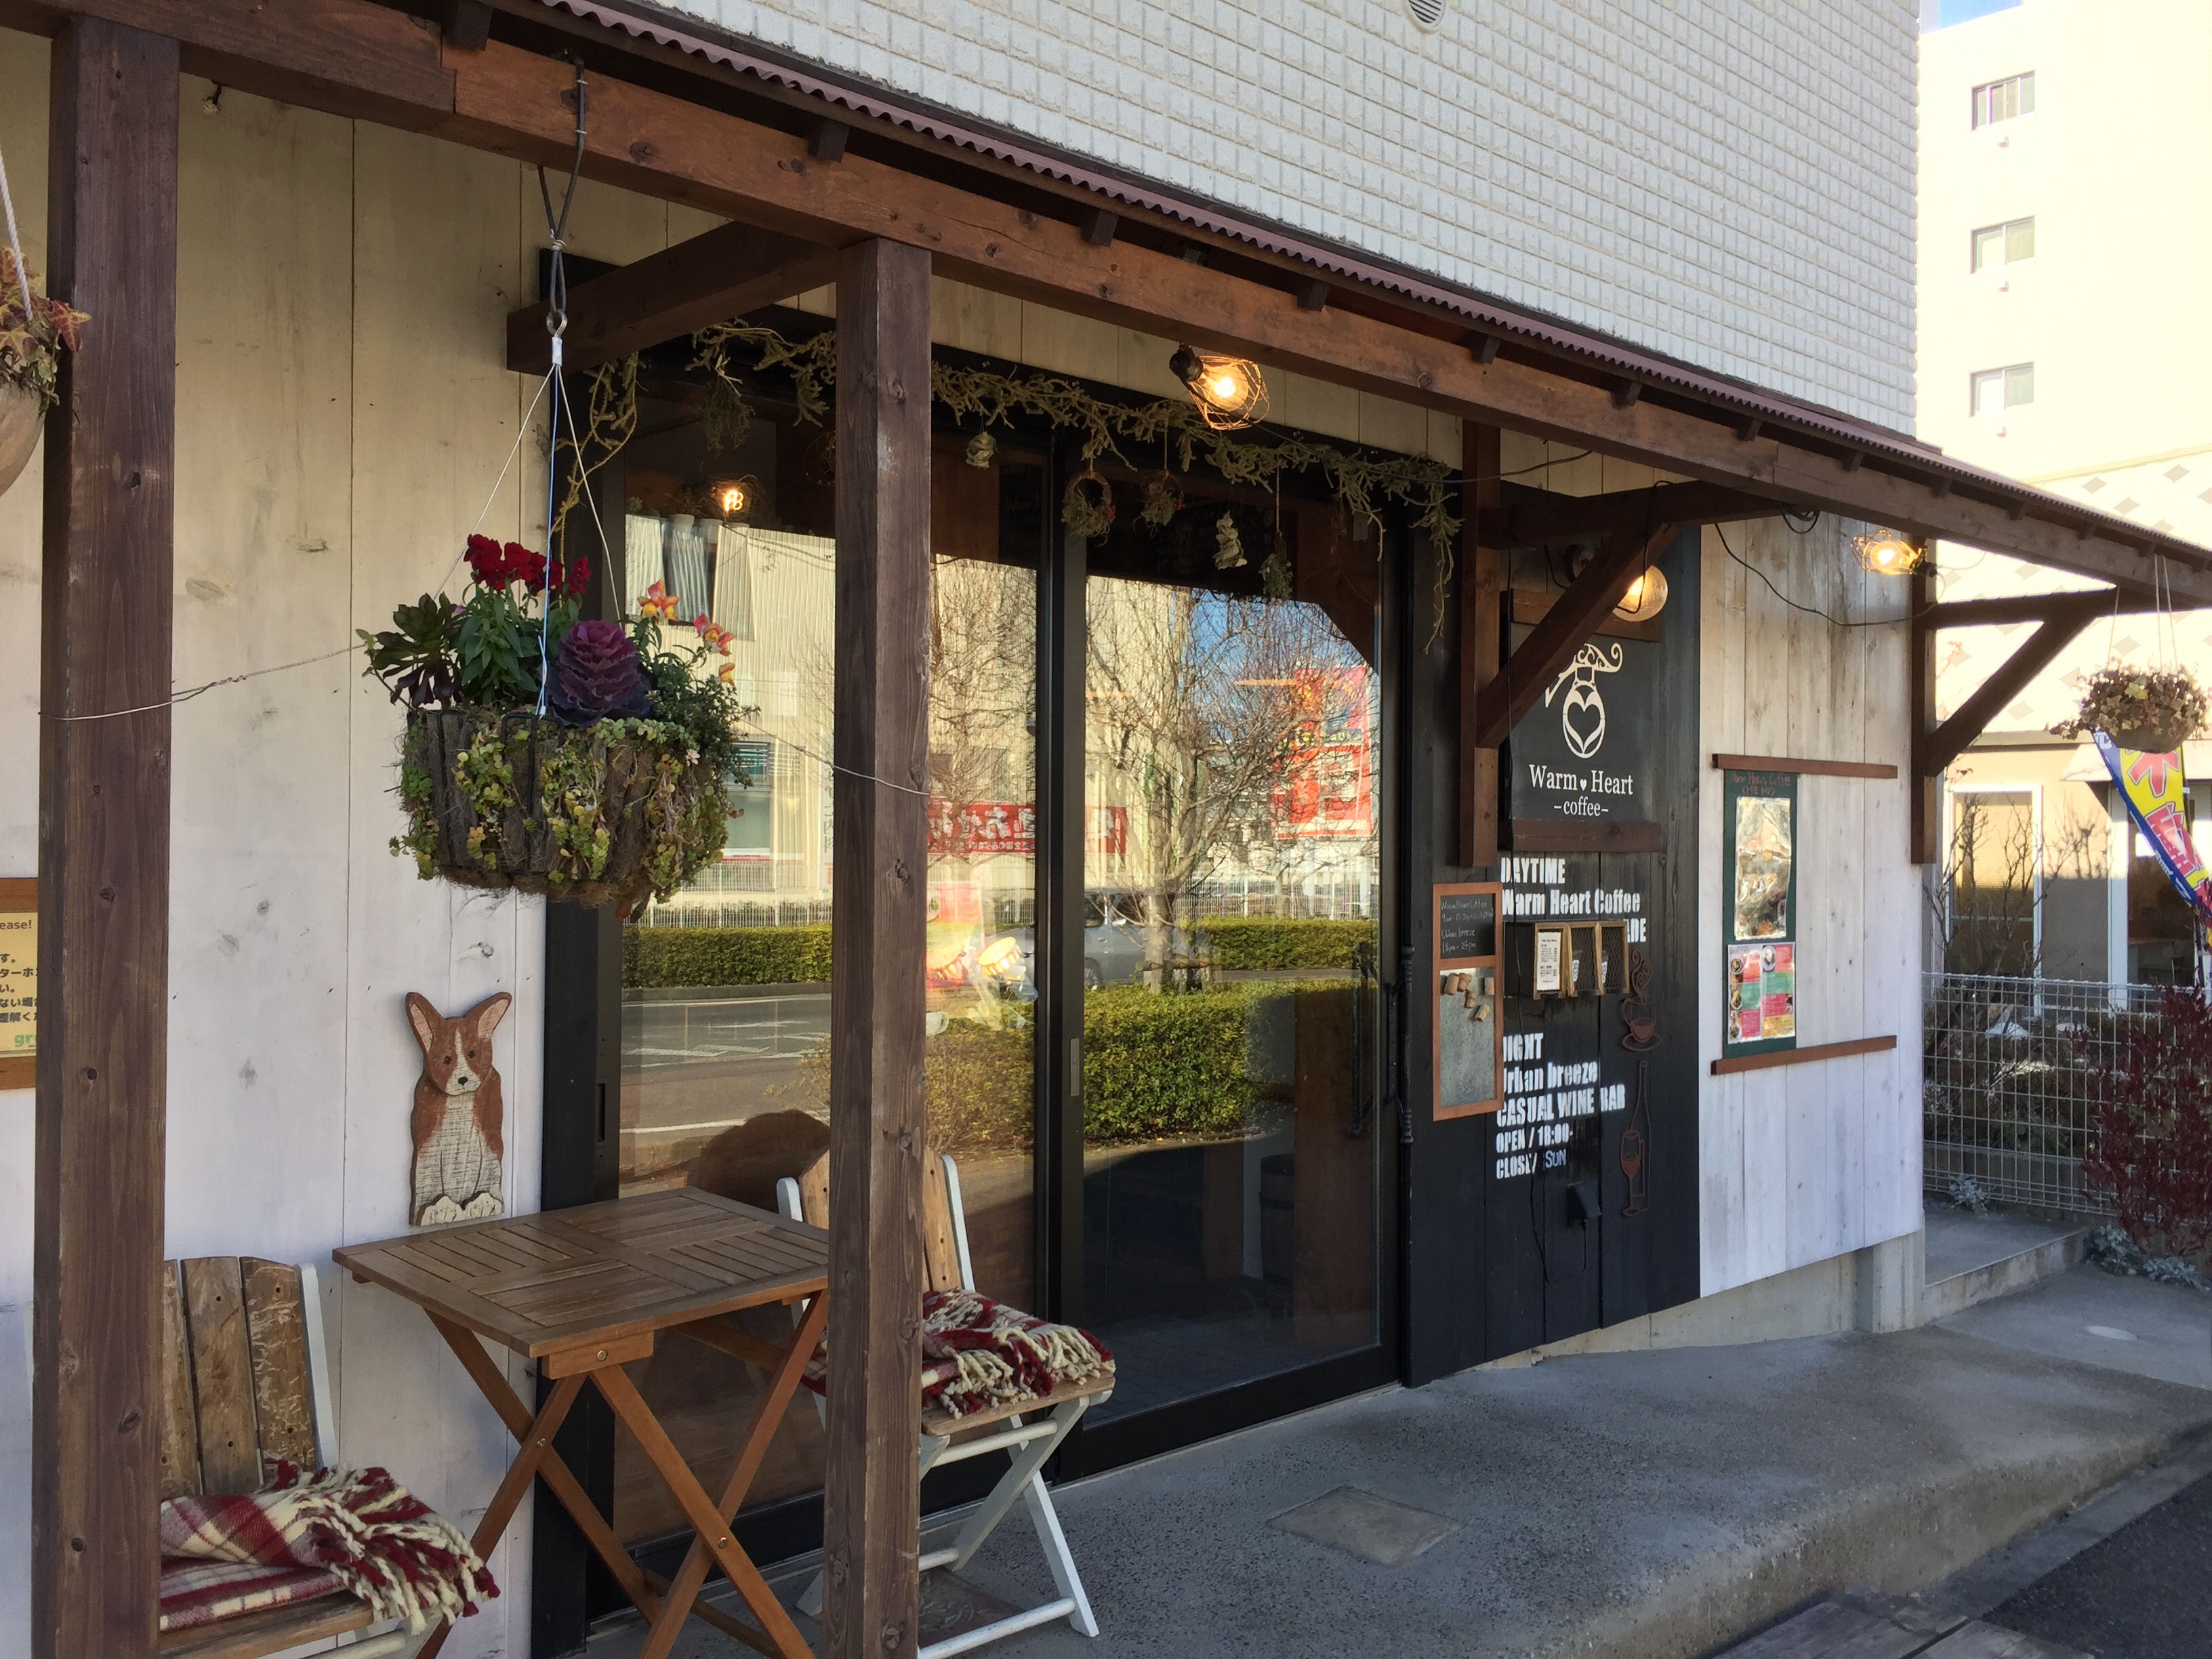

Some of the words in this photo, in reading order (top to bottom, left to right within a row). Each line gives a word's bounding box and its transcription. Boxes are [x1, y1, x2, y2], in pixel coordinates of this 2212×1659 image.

[1529, 764, 1578, 791] Warm
[1591, 770, 1634, 795] Heart
[1500, 857, 1565, 884] DAYTIME
[1502, 888, 1545, 915] Warm
[1550, 889, 1591, 915] Heart
[1594, 888, 1641, 914] Coffee
[0, 967, 38, 978] ターホ
[1547, 1061, 1598, 1089] breeze
[1496, 1094, 1555, 1127] CASUAL
[1557, 1088, 1595, 1118] WINE
[1600, 1084, 1626, 1112] BAR
[1496, 1128, 1526, 1153] OPEN
[1544, 1149, 1567, 1170] SUN
